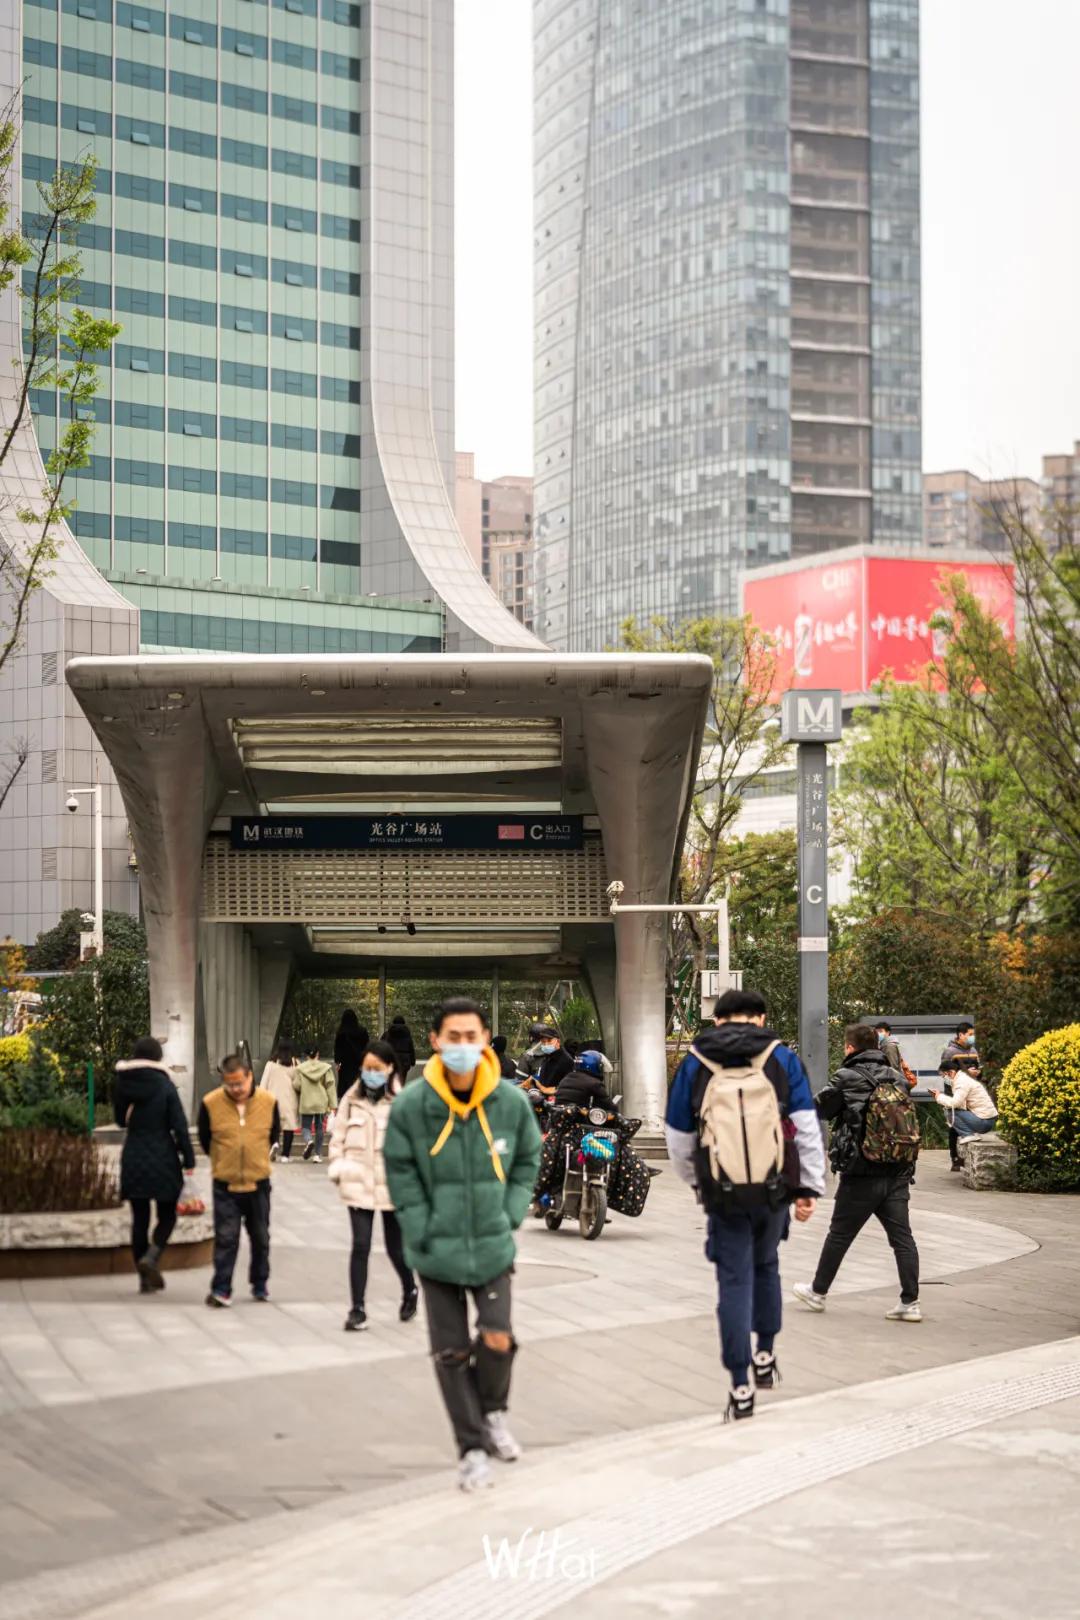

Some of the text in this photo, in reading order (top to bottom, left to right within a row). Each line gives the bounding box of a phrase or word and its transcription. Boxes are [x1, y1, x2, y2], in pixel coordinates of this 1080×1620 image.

[798, 697, 834, 733] M
[812, 773, 824, 848] 光谷广场站
[369, 822, 442, 836] 光谷广场站
[530, 824, 543, 840] C
[545, 824, 571, 833] 出入口
[806, 885, 823, 904] C
